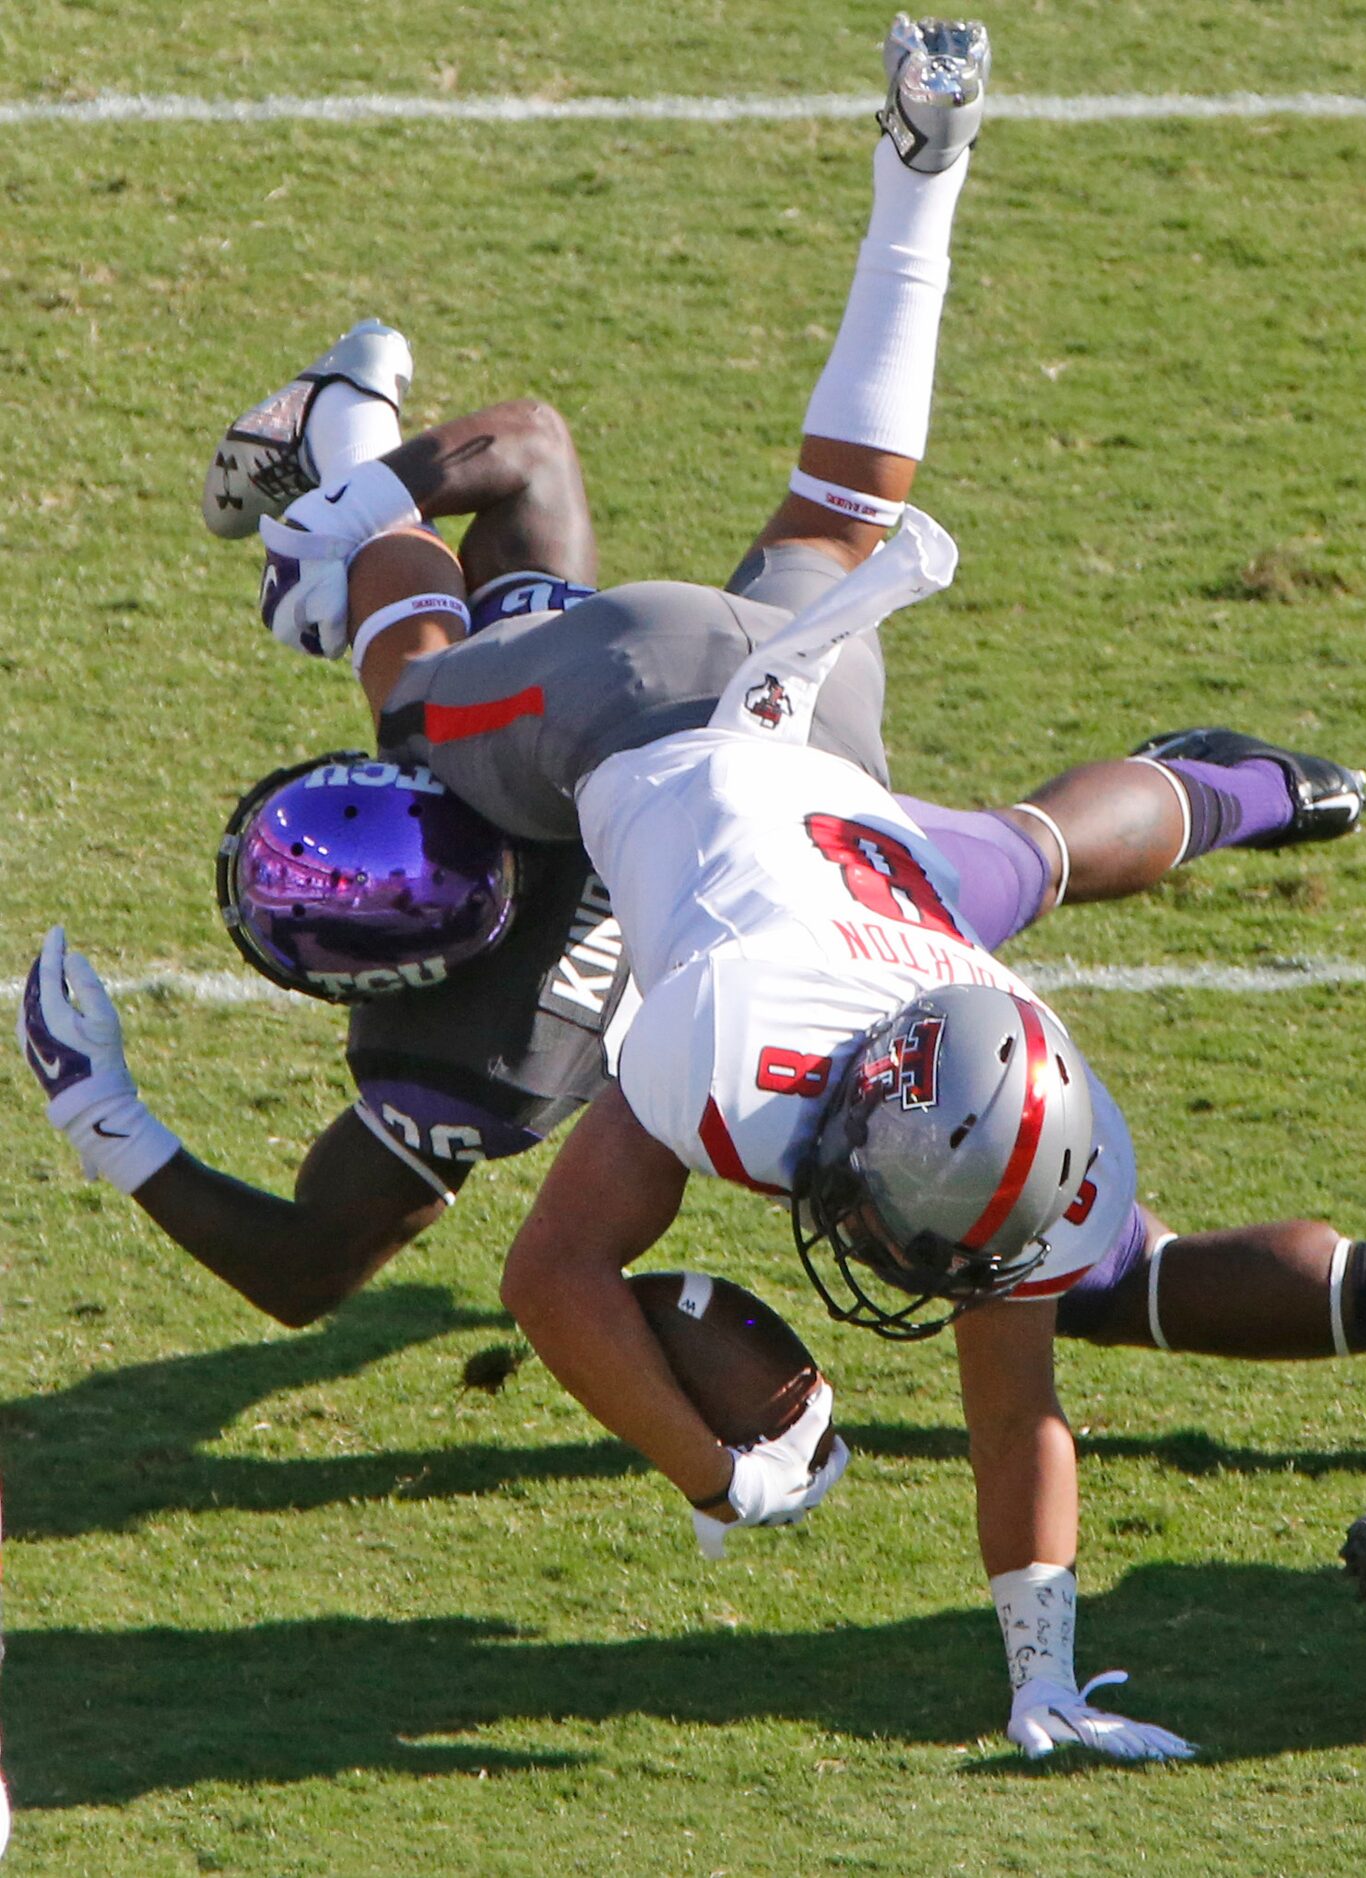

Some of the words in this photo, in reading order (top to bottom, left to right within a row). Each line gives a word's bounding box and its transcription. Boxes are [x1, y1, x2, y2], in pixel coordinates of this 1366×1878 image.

[304, 761, 446, 796] TCU
[306, 955, 449, 996] TCU
[756, 1045, 833, 1098] 8
